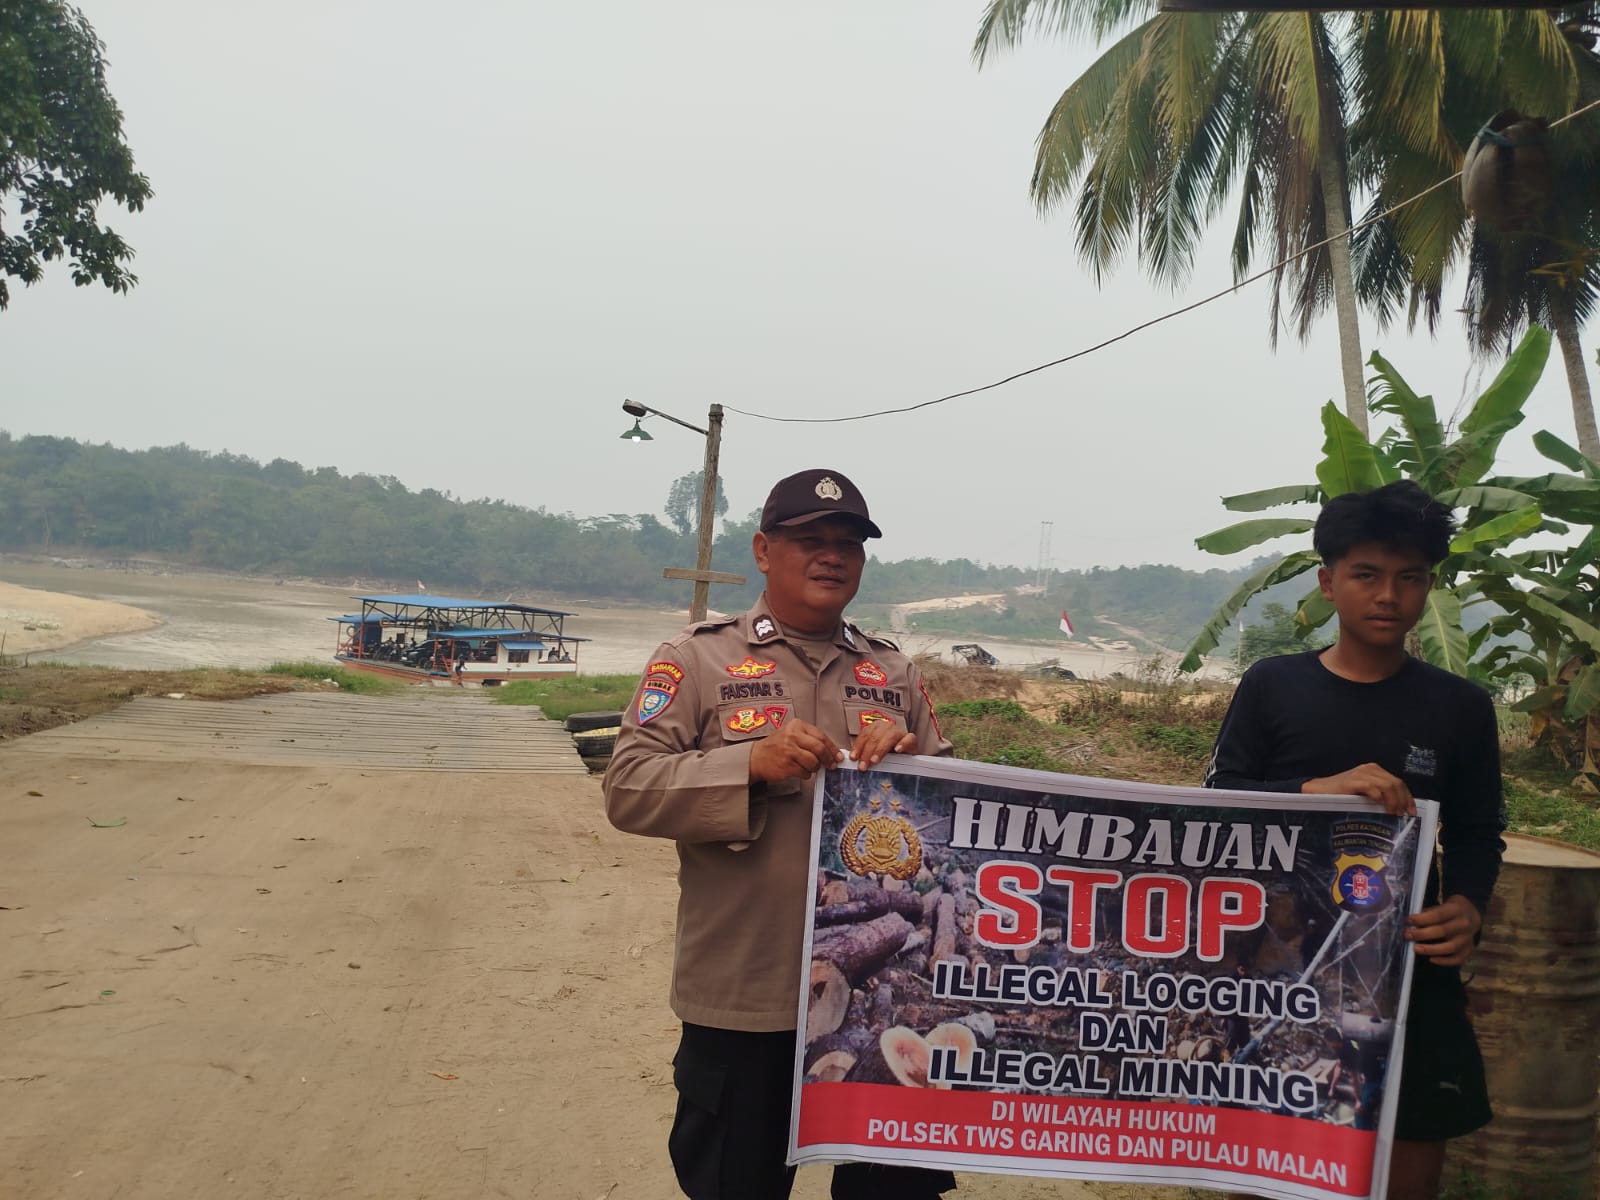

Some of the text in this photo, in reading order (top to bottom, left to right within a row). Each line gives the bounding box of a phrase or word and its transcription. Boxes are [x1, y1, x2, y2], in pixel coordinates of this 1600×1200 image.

[774, 682, 783, 696] S
[845, 686, 901, 706] POLRI
[949, 797, 1303, 872] HIMBAUAN
[975, 860, 1267, 962] STOP
[933, 961, 1320, 1022] ILLEGAL LOGGING
[1080, 1012, 1168, 1053] DAN
[929, 1048, 1318, 1112] ILLEGAL MINNING
[992, 1100, 1216, 1135] DI WILAYAH HUKUM
[867, 1118, 1347, 1187] POLSEK TWS GARING DAN PULAU MALAN
